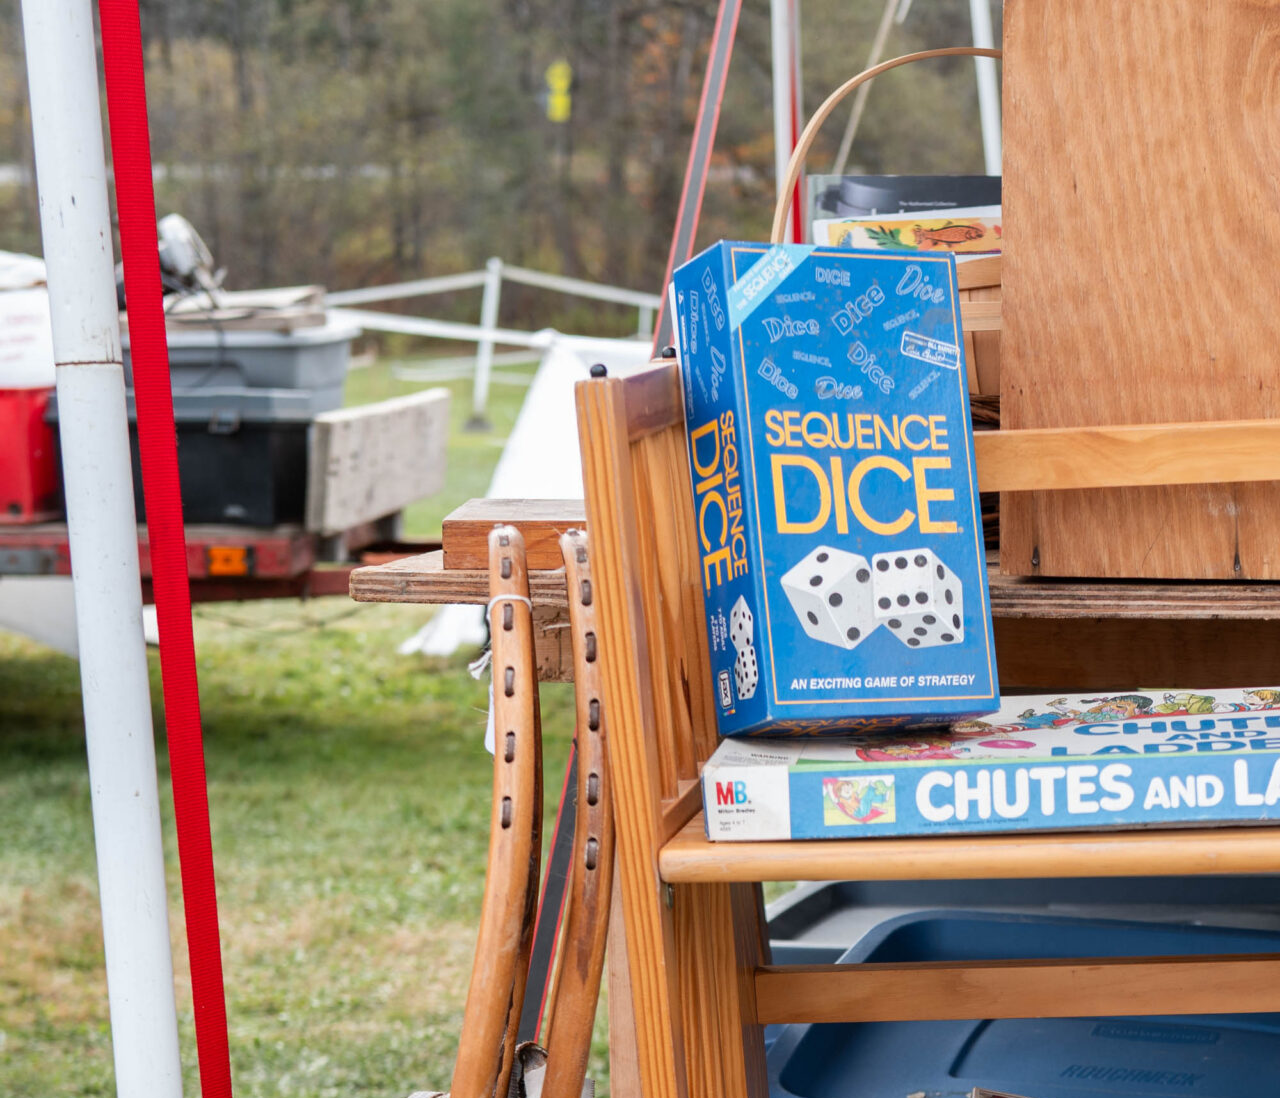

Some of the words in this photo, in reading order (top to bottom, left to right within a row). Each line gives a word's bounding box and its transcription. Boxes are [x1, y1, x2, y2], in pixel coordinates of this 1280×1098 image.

[815, 266, 851, 287] DICE
[895, 264, 945, 304] Dice
[701, 266, 725, 331] Dice
[831, 285, 885, 336] Dice
[762, 315, 820, 343] Dice
[710, 345, 726, 402] Dice
[758, 357, 799, 400] Dice
[814, 376, 863, 400] Dice
[847, 341, 895, 394] Dice
[764, 409, 949, 450] SEQUENCE
[691, 419, 733, 590] DICE
[720, 410, 748, 578] SEQUENCE
[770, 454, 959, 535] DICE
[791, 677, 807, 690] AN
[809, 676, 861, 689] EXCITING
[864, 676, 898, 688] GAME
[900, 676, 915, 687] OF
[918, 674, 975, 687] STRATEGY
[1164, 730, 1267, 742] AND
[716, 781, 748, 806] MB
[915, 762, 1135, 822] CHUTES
[1144, 774, 1224, 810] AND
[1060, 1064, 1208, 1087] ROUGHNECK
